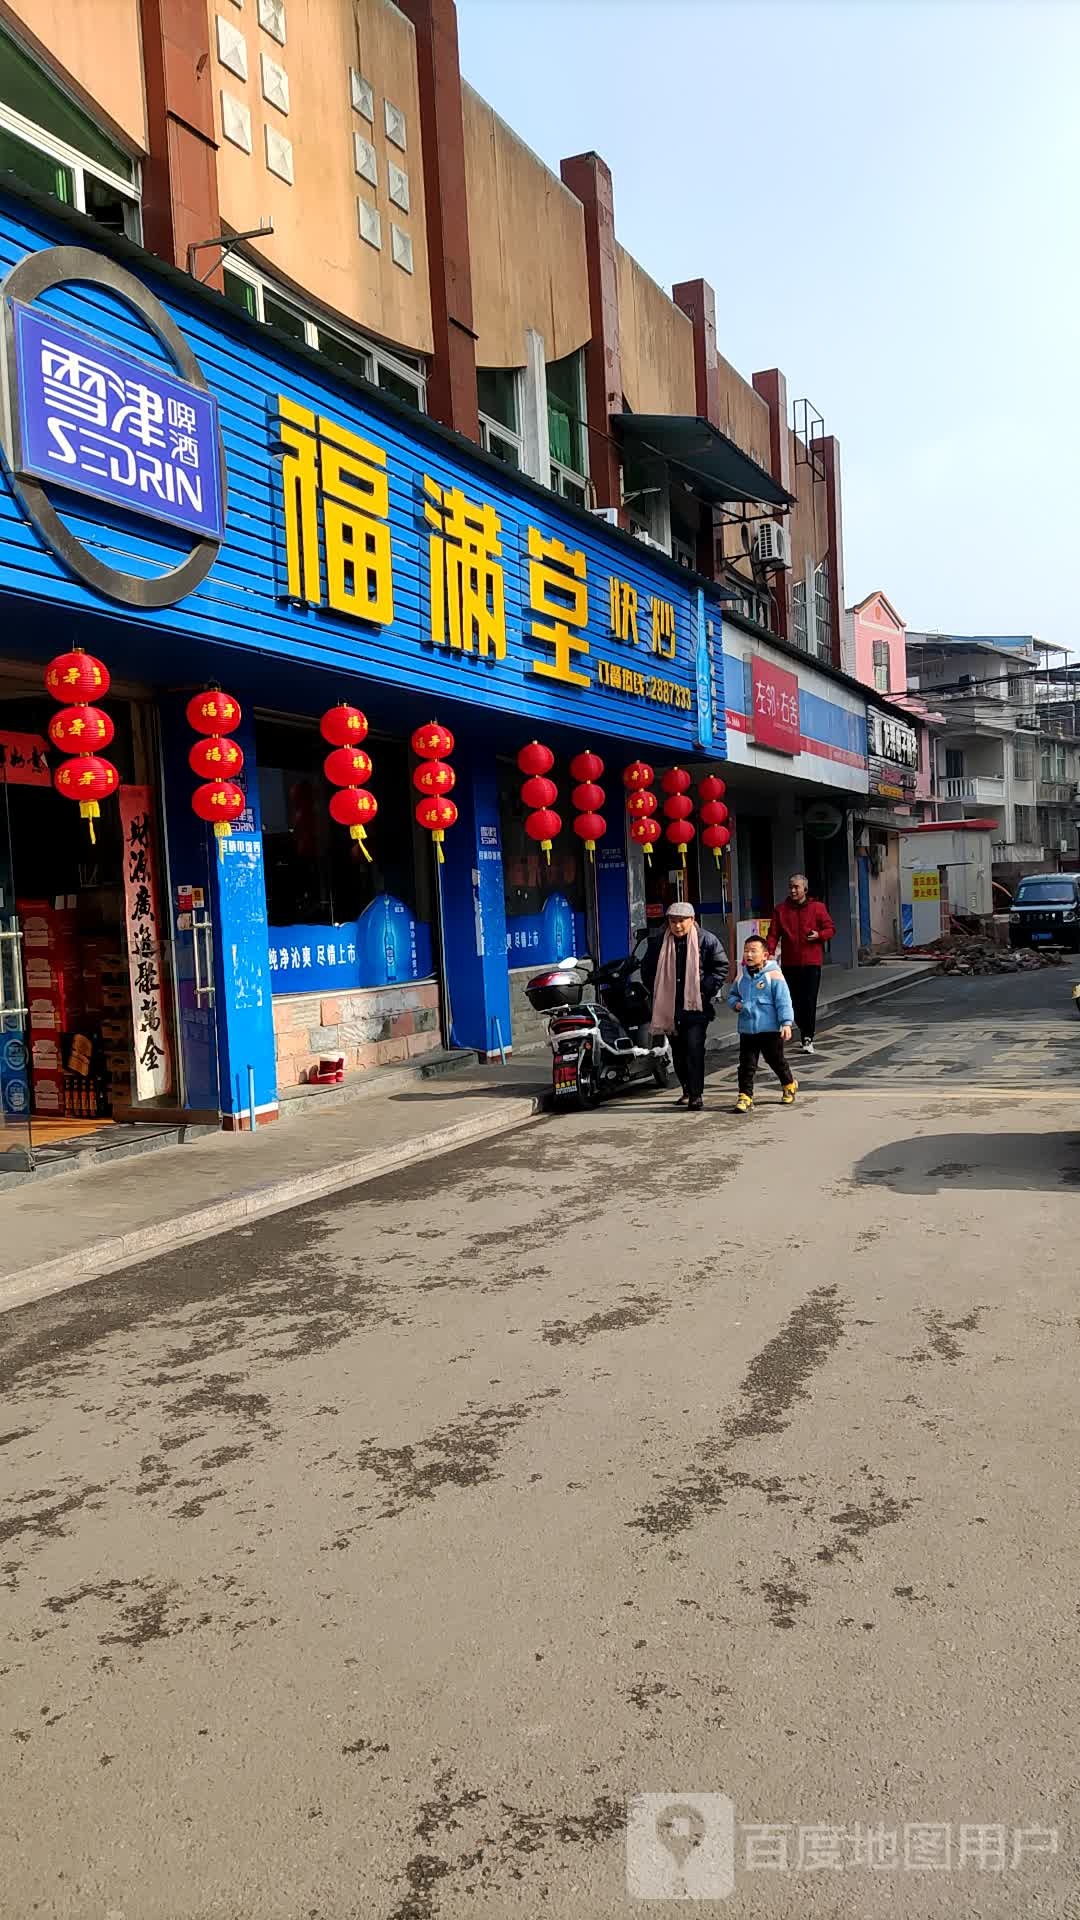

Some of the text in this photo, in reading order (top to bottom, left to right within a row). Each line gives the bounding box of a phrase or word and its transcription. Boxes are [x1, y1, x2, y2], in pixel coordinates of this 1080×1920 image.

[41, 338, 166, 450] 雪津
[167, 397, 200, 469] 啤酒
[47, 416, 203, 513] SEDRIN
[277, 395, 591, 689] 福满堂
[608, 575, 677, 660] 快炒
[268, 943, 356, 970] 纯净沁爽 尽情上市
